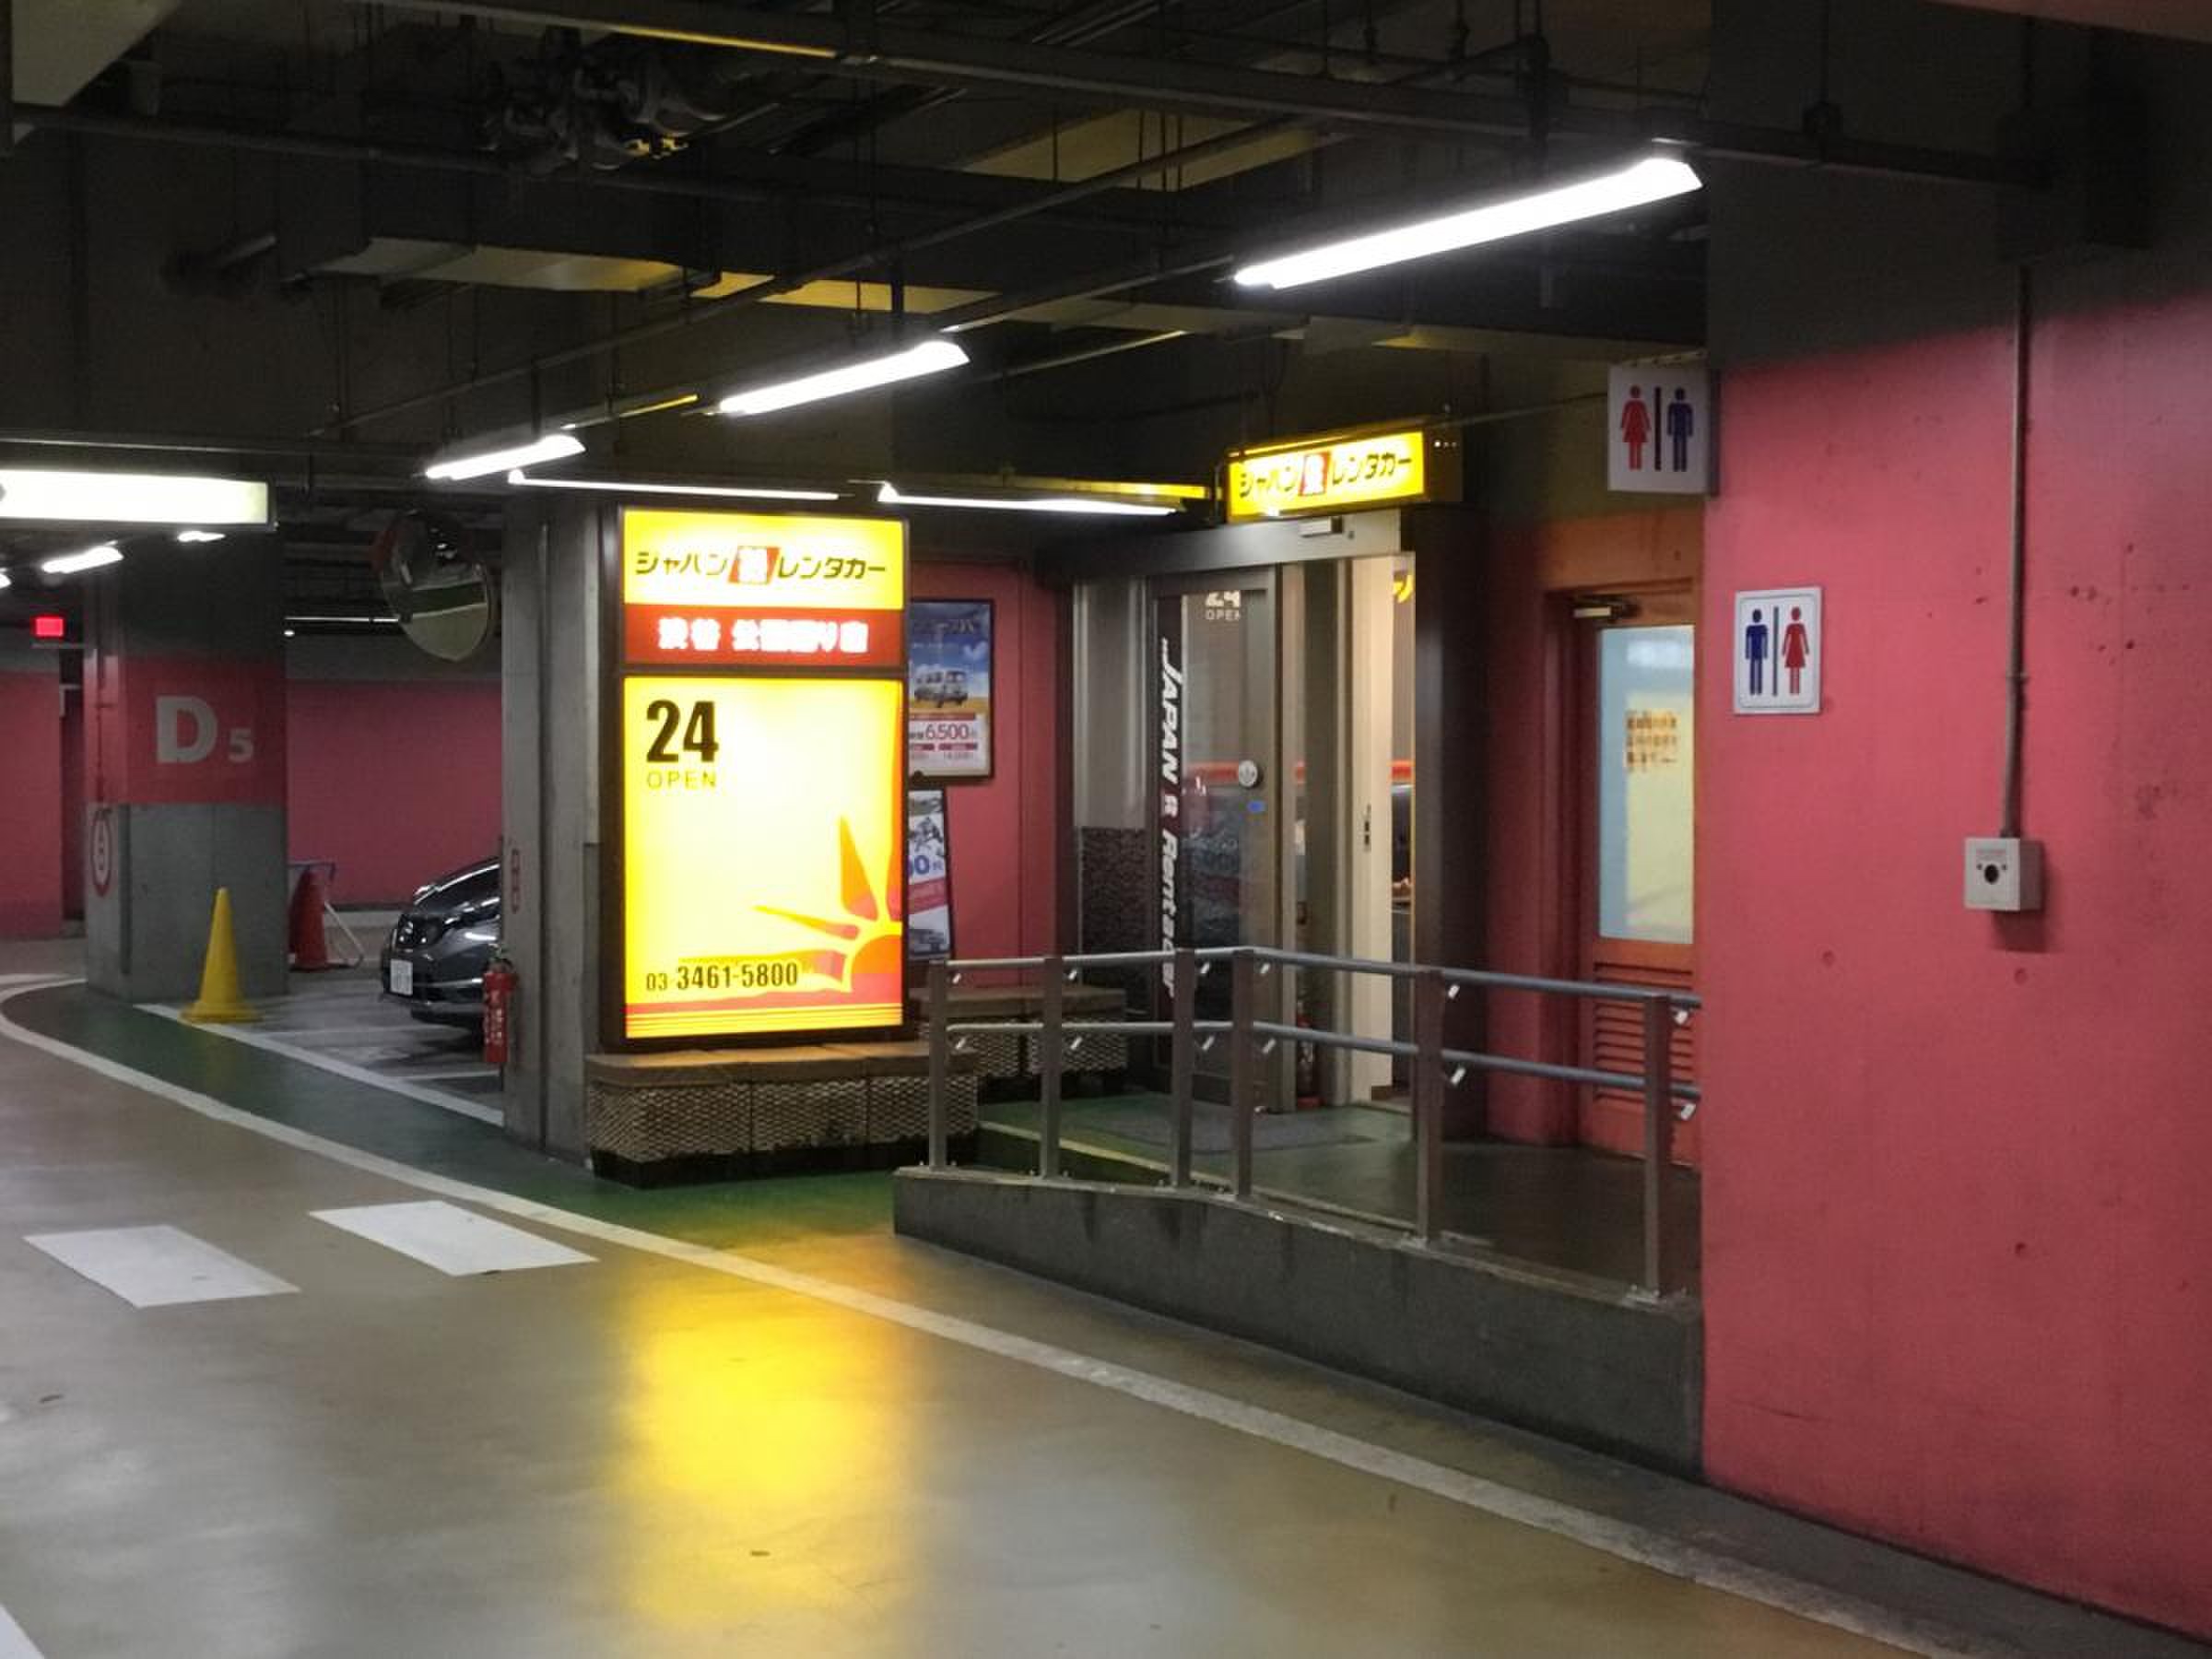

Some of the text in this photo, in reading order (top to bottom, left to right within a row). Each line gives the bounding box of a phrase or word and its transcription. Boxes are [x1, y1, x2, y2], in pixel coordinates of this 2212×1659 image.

[647, 700, 719, 763] 24
[1161, 637, 1182, 784] JAPAN
[647, 771, 716, 788] OPEN
[677, 961, 798, 990] 3461-5800
